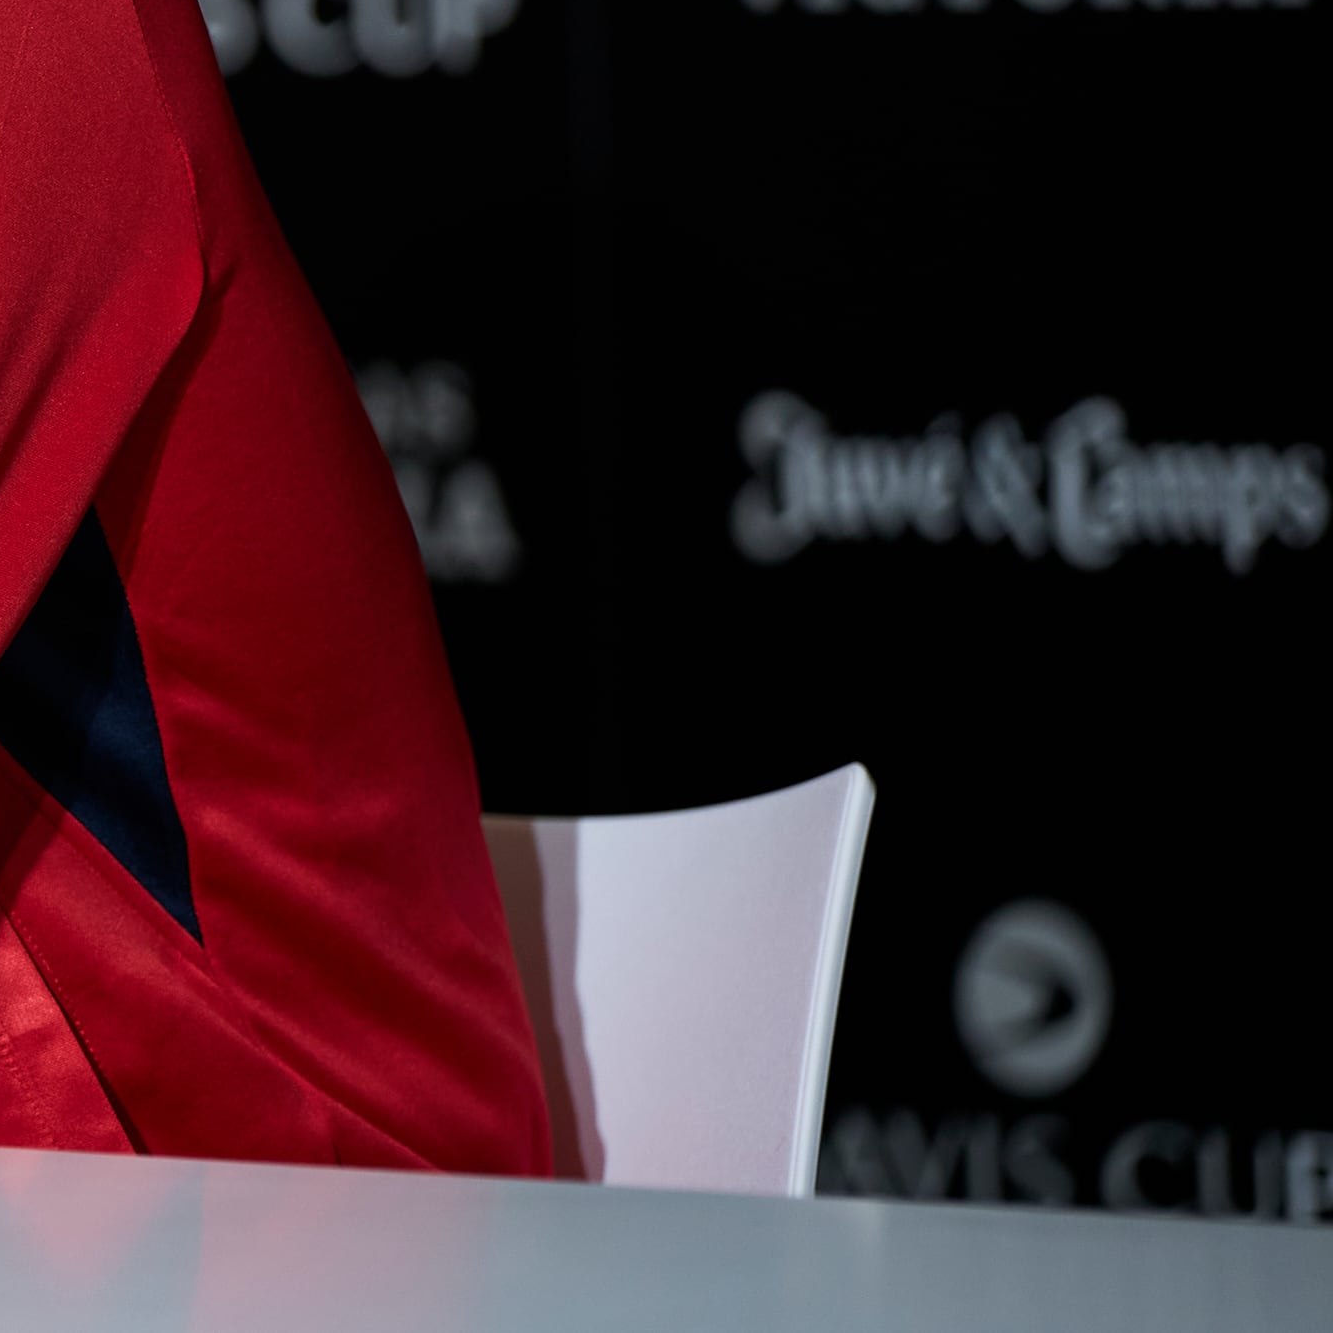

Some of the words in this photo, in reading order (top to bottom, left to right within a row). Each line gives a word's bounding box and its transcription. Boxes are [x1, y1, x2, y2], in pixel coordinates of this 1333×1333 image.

[729, 387, 967, 567] Juvé
[1044, 392, 1332, 577] Camps
[816, 1101, 1078, 1205] AVIS
